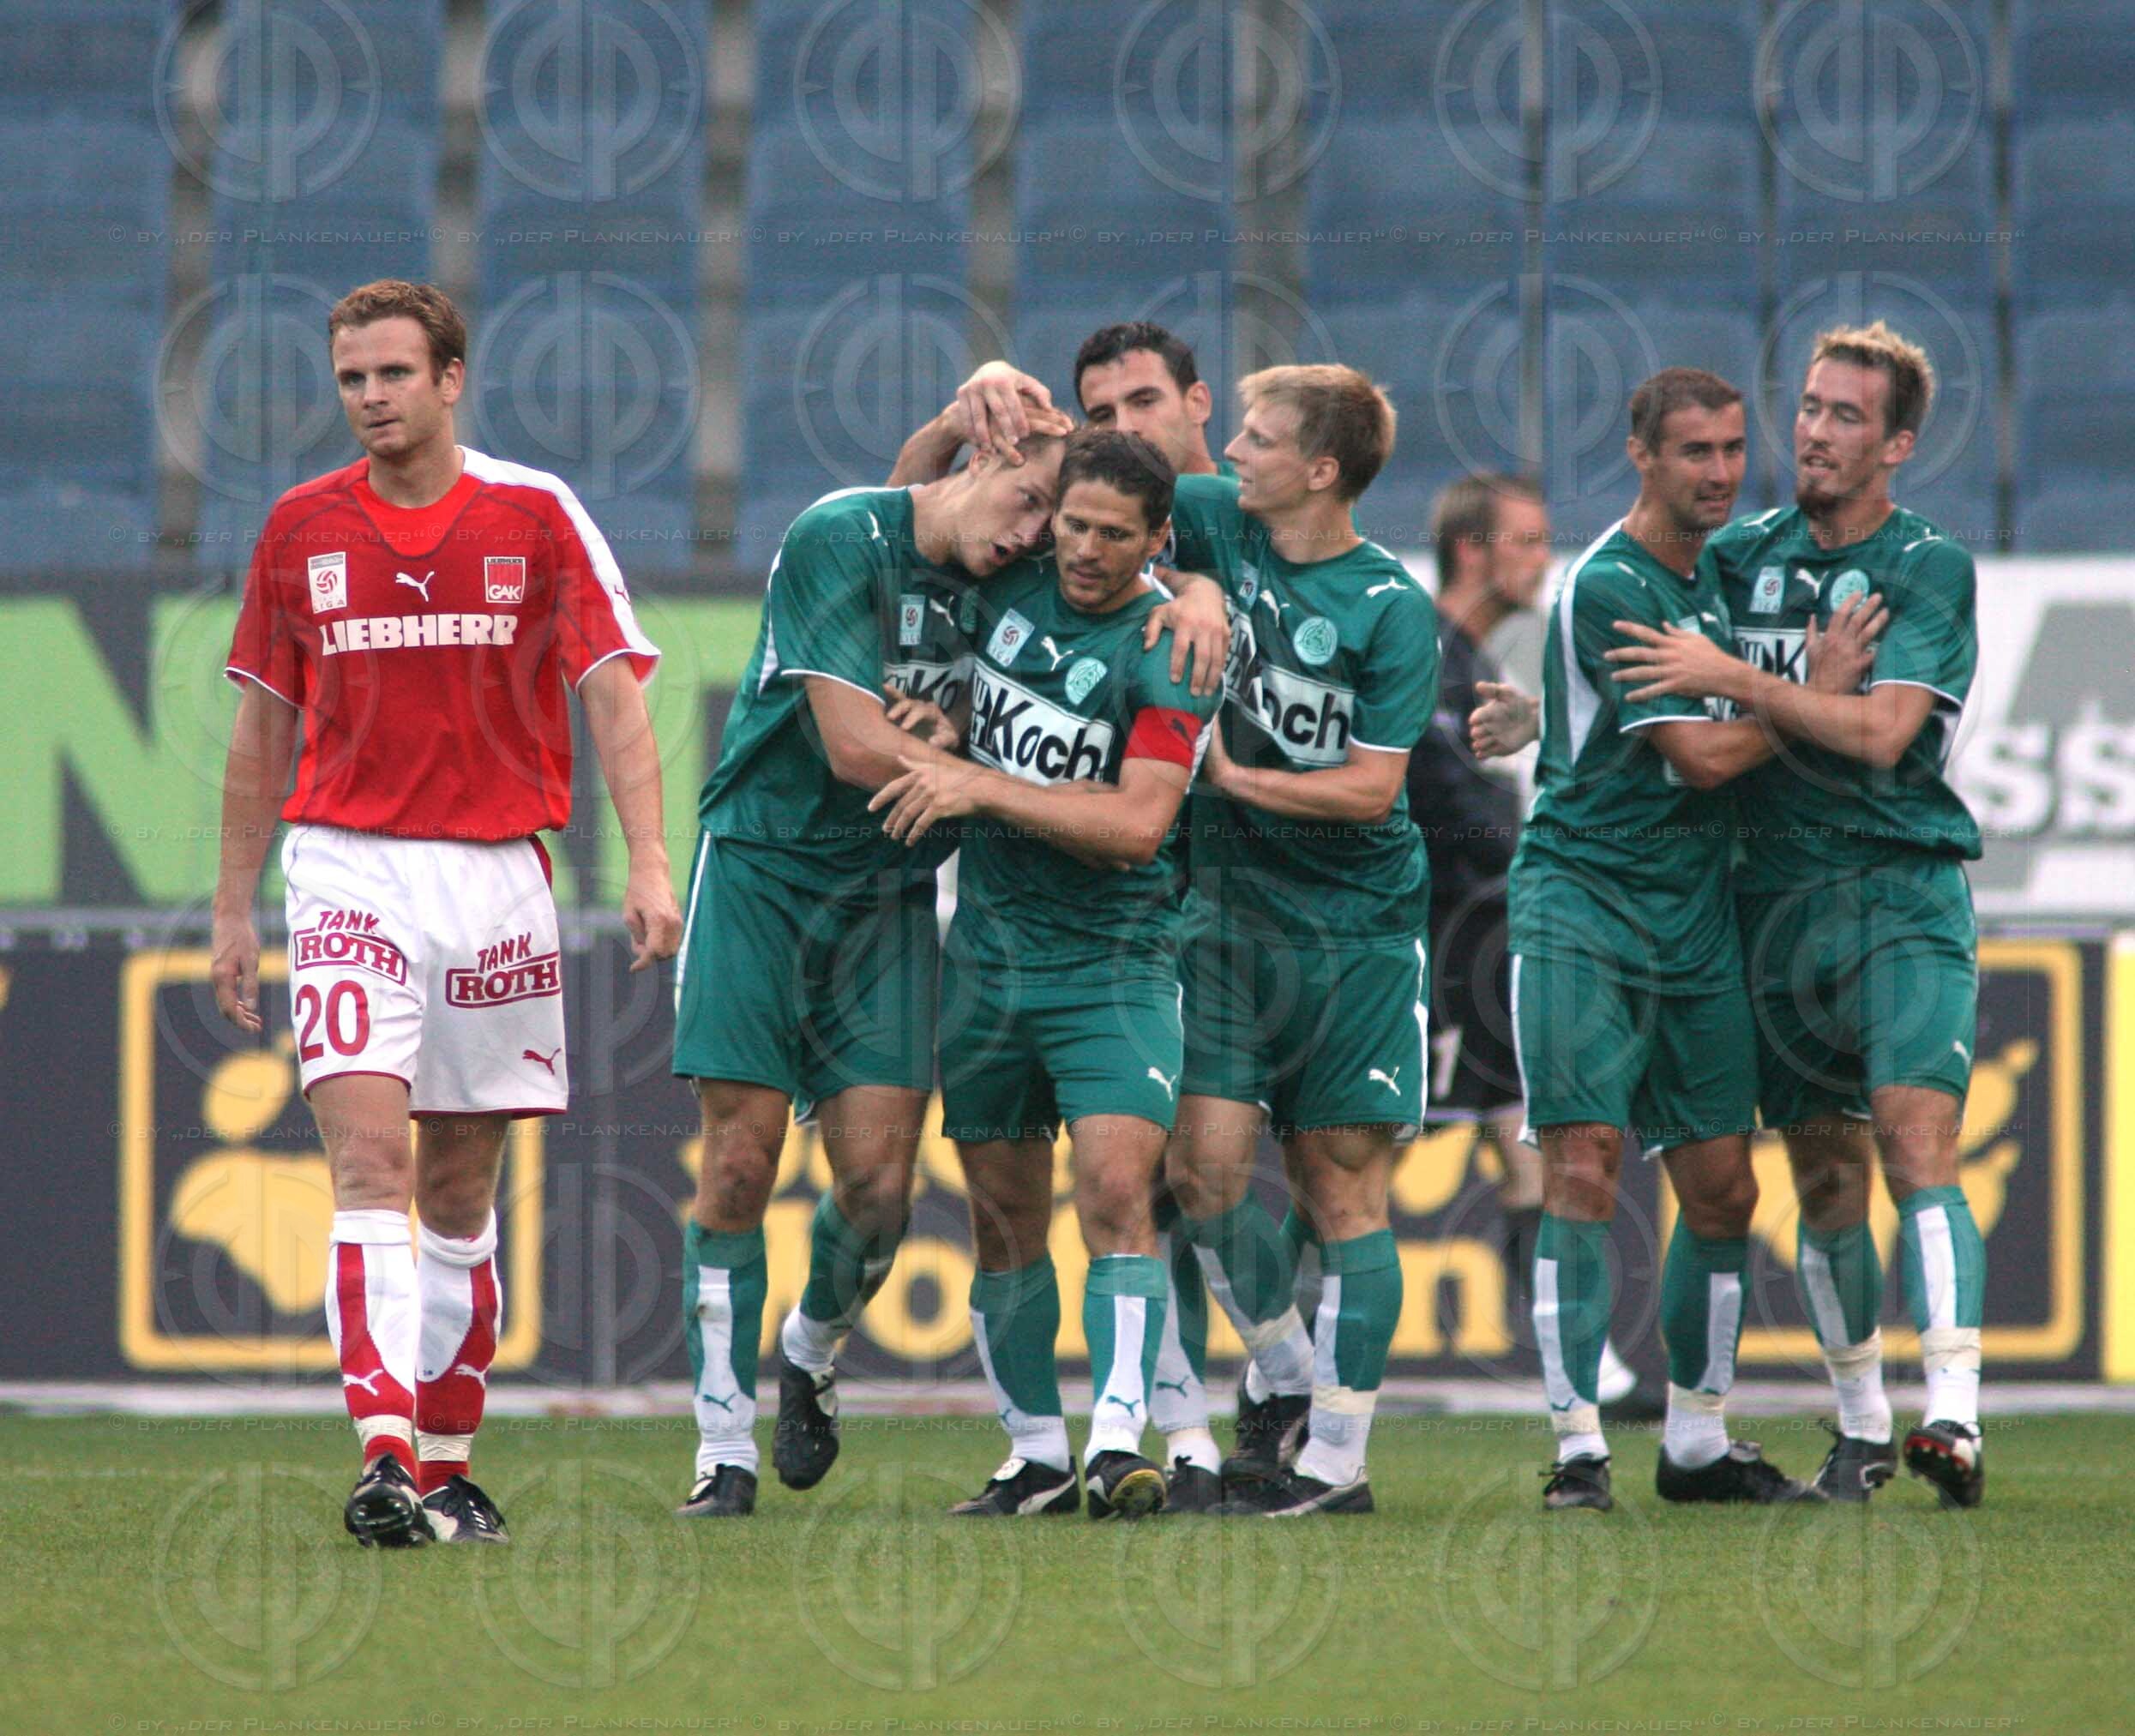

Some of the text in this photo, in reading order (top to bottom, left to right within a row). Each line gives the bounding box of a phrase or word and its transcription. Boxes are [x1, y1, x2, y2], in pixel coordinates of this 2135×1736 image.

[489, 584, 522, 600] GAK
[320, 613, 519, 656] LIEBHERR
[989, 685, 1103, 781] Koch
[317, 910, 381, 934] TANK
[300, 933, 400, 977] ROTH
[477, 932, 532, 974] TANK
[455, 958, 559, 1001] ROTH
[295, 979, 370, 1064] 20
